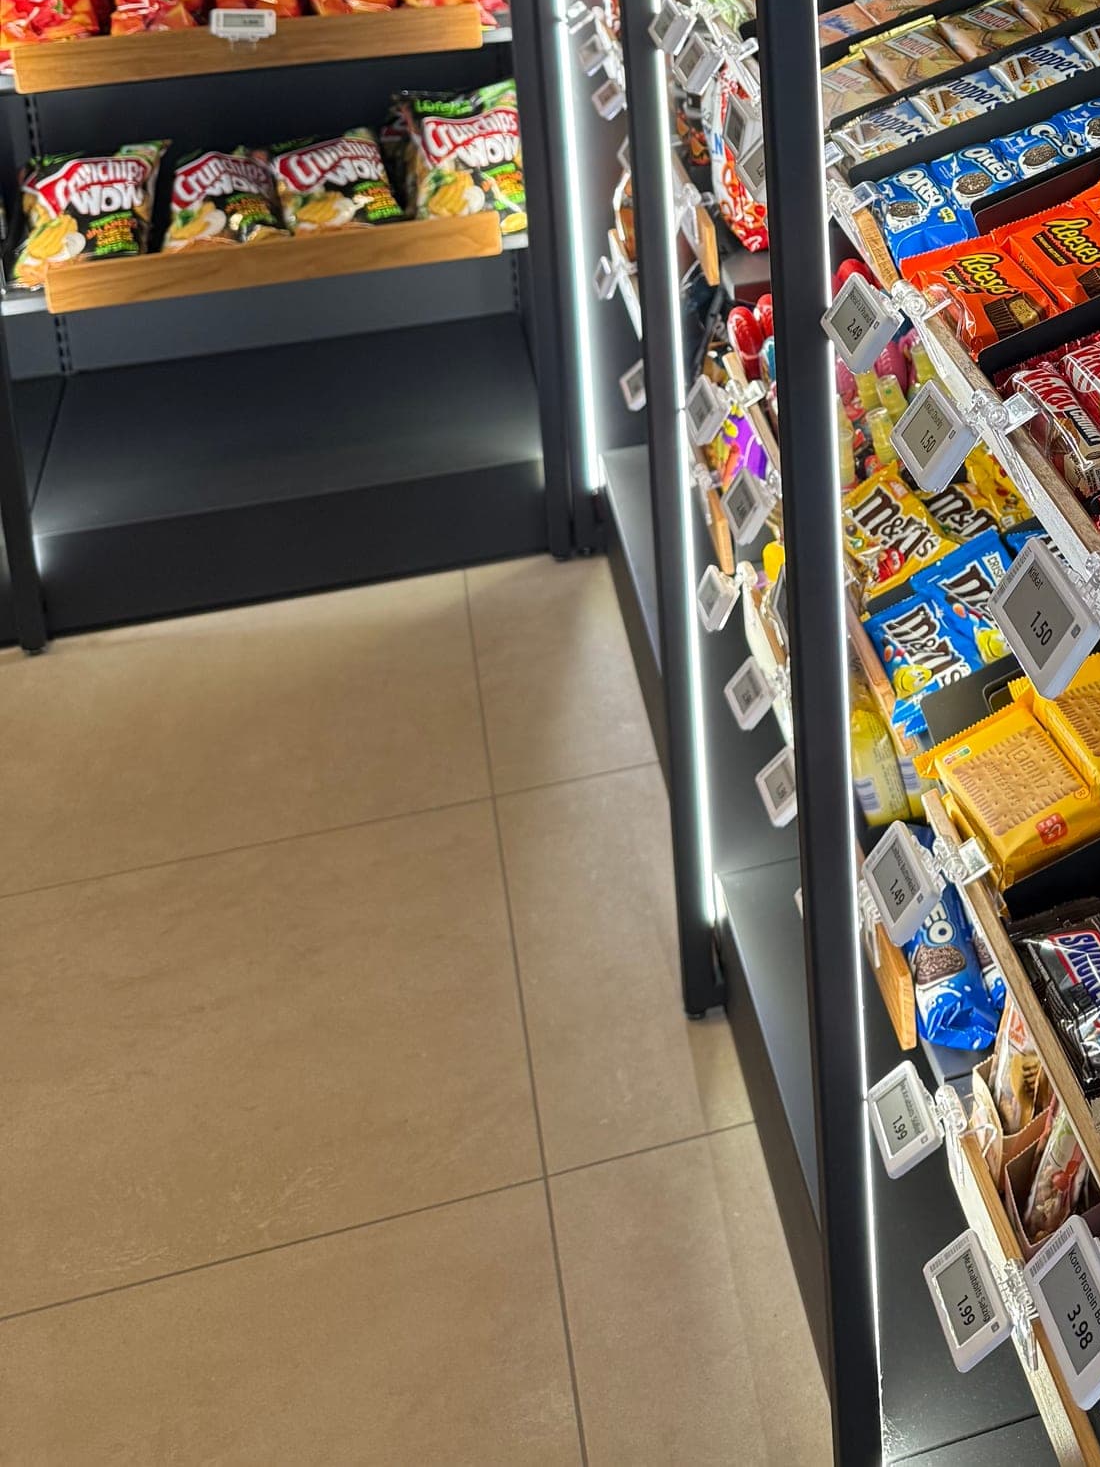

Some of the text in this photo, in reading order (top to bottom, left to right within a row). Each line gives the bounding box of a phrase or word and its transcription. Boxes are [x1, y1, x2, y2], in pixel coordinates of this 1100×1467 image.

[424, 108, 519, 159] Crunchips
[457, 134, 519, 168] WOW
[287, 138, 378, 185] Crunchips
[962, 144, 1013, 184] OREO
[71, 182, 146, 216] WOW
[898, 167, 946, 206] OREO
[919, 429, 937, 453] 1.50
[1028, 610, 1053, 647] 1.50
[889, 878, 906, 907] 1.49
[892, 1114, 908, 1141] 1.99
[1067, 1248, 1083, 1273] Koro
[1078, 1271, 1099, 1308] Protein
[957, 1294, 976, 1328] 1.99
[1066, 1304, 1094, 1351] 3.98
